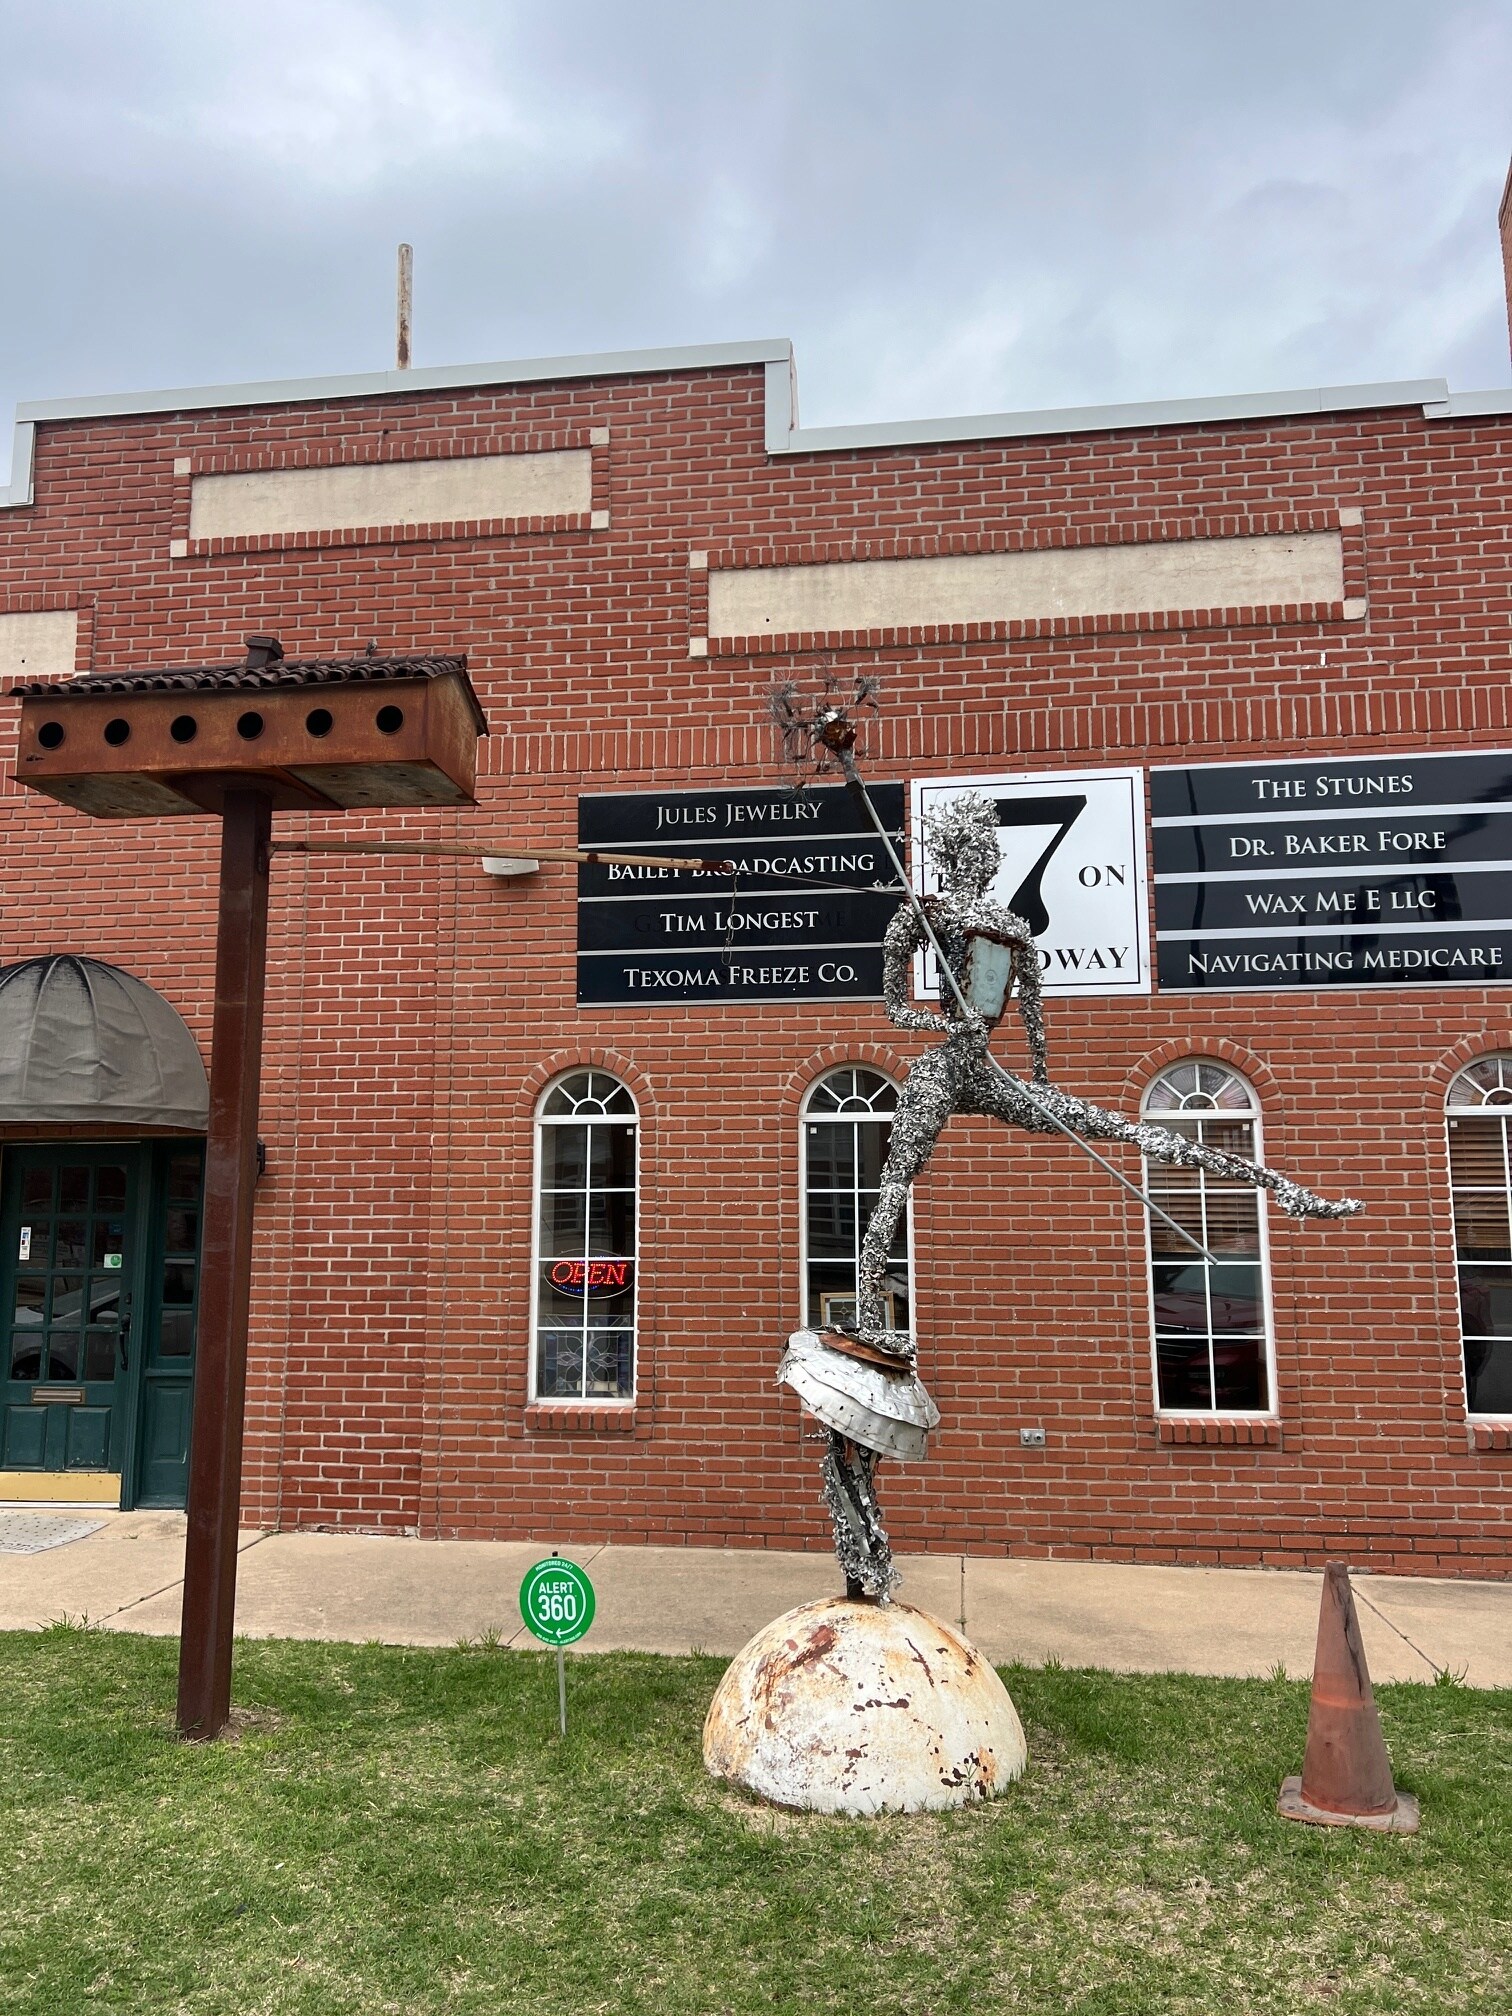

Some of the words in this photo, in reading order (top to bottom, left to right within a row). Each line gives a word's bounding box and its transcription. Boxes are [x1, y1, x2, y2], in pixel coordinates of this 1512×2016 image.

[1252, 779, 1307, 799] THE
[1316, 775, 1414, 797] STUNES
[656, 805, 717, 830] JULES
[724, 802, 823, 828] JEWELRY
[1229, 837, 1275, 858] DR.
[1284, 834, 1371, 855] BAKER
[1378, 831, 1447, 851] FORE
[983, 795, 1088, 938] 7
[1078, 864, 1127, 888] ON
[1245, 893, 1307, 915] WAX
[1315, 891, 1357, 912] ME
[1366, 889, 1381, 910] E
[1391, 890, 1437, 910] LLC
[660, 912, 706, 932] TIM
[714, 910, 819, 931] LONGEST
[1188, 951, 1354, 975] NAVIGATING
[1363, 947, 1504, 969] MEDICARE
[623, 967, 720, 989] TEXOMA
[728, 964, 810, 986] FREEZE
[817, 962, 859, 983] CO.
[551, 1261, 627, 1285] OPEN
[538, 1582, 575, 1593] ALERT
[538, 1595, 577, 1621] 360
